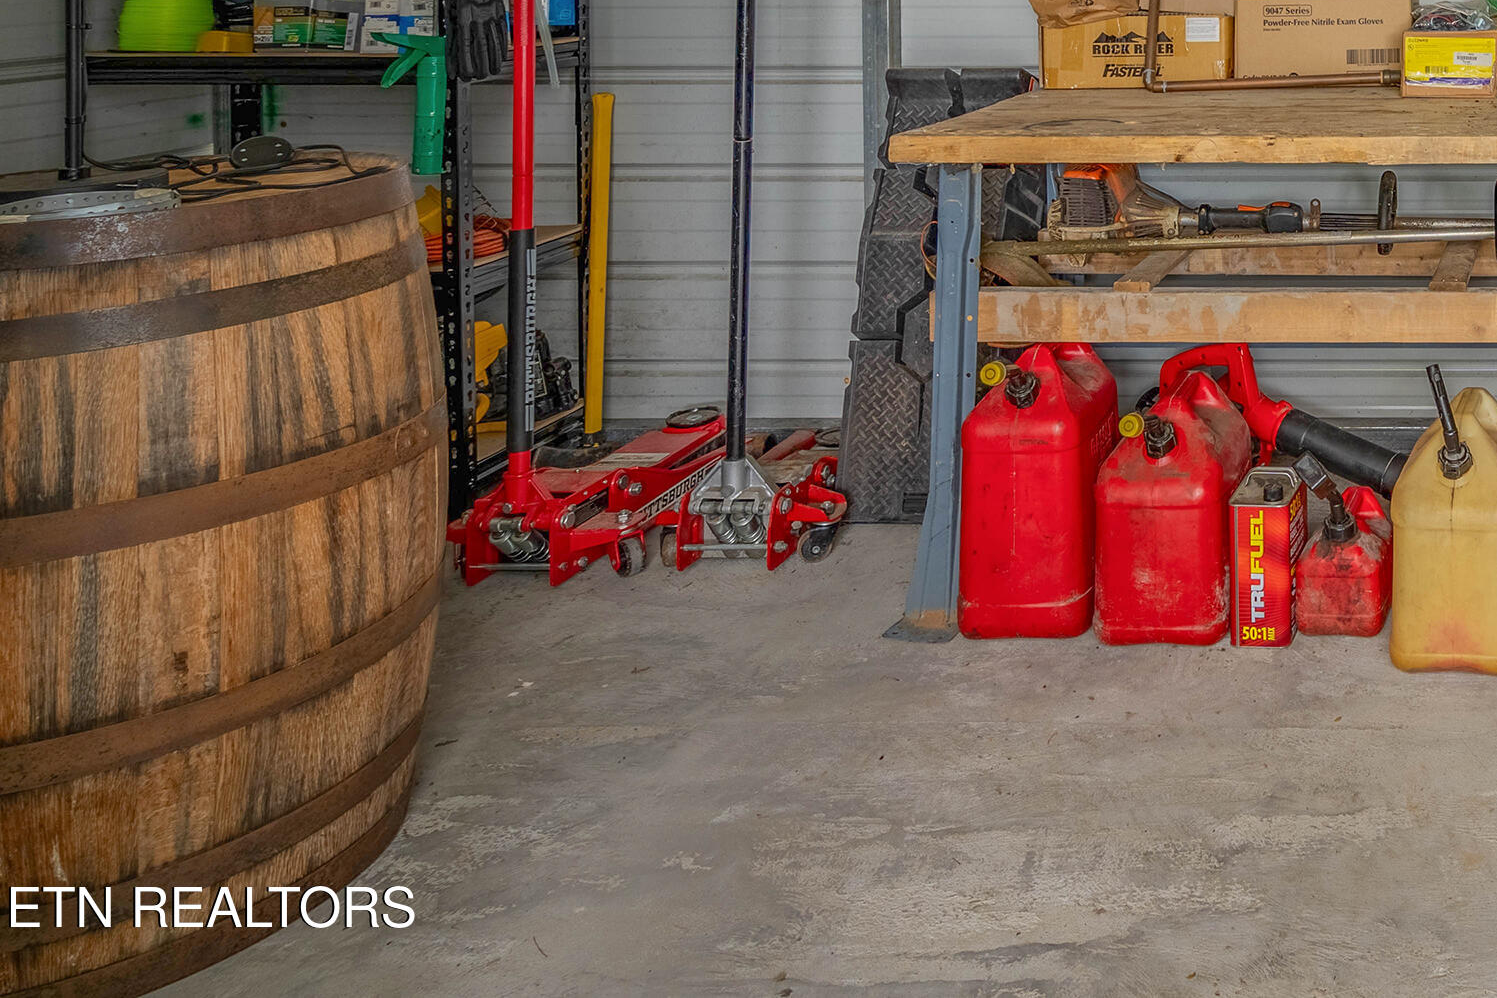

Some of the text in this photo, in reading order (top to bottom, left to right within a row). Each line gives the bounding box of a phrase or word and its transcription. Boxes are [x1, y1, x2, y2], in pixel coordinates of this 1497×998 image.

[1265, 6, 1310, 15] 9047 Series
[1263, 18, 1310, 27] Powder-Free
[1311, 18, 1335, 26] Nitrile
[1092, 43, 1174, 55] ROCK RIER
[640, 468, 705, 518] TTSBURGH
[1250, 510, 1265, 623] TRUFUEL
[1242, 626, 1275, 641] 50:1 MIX
